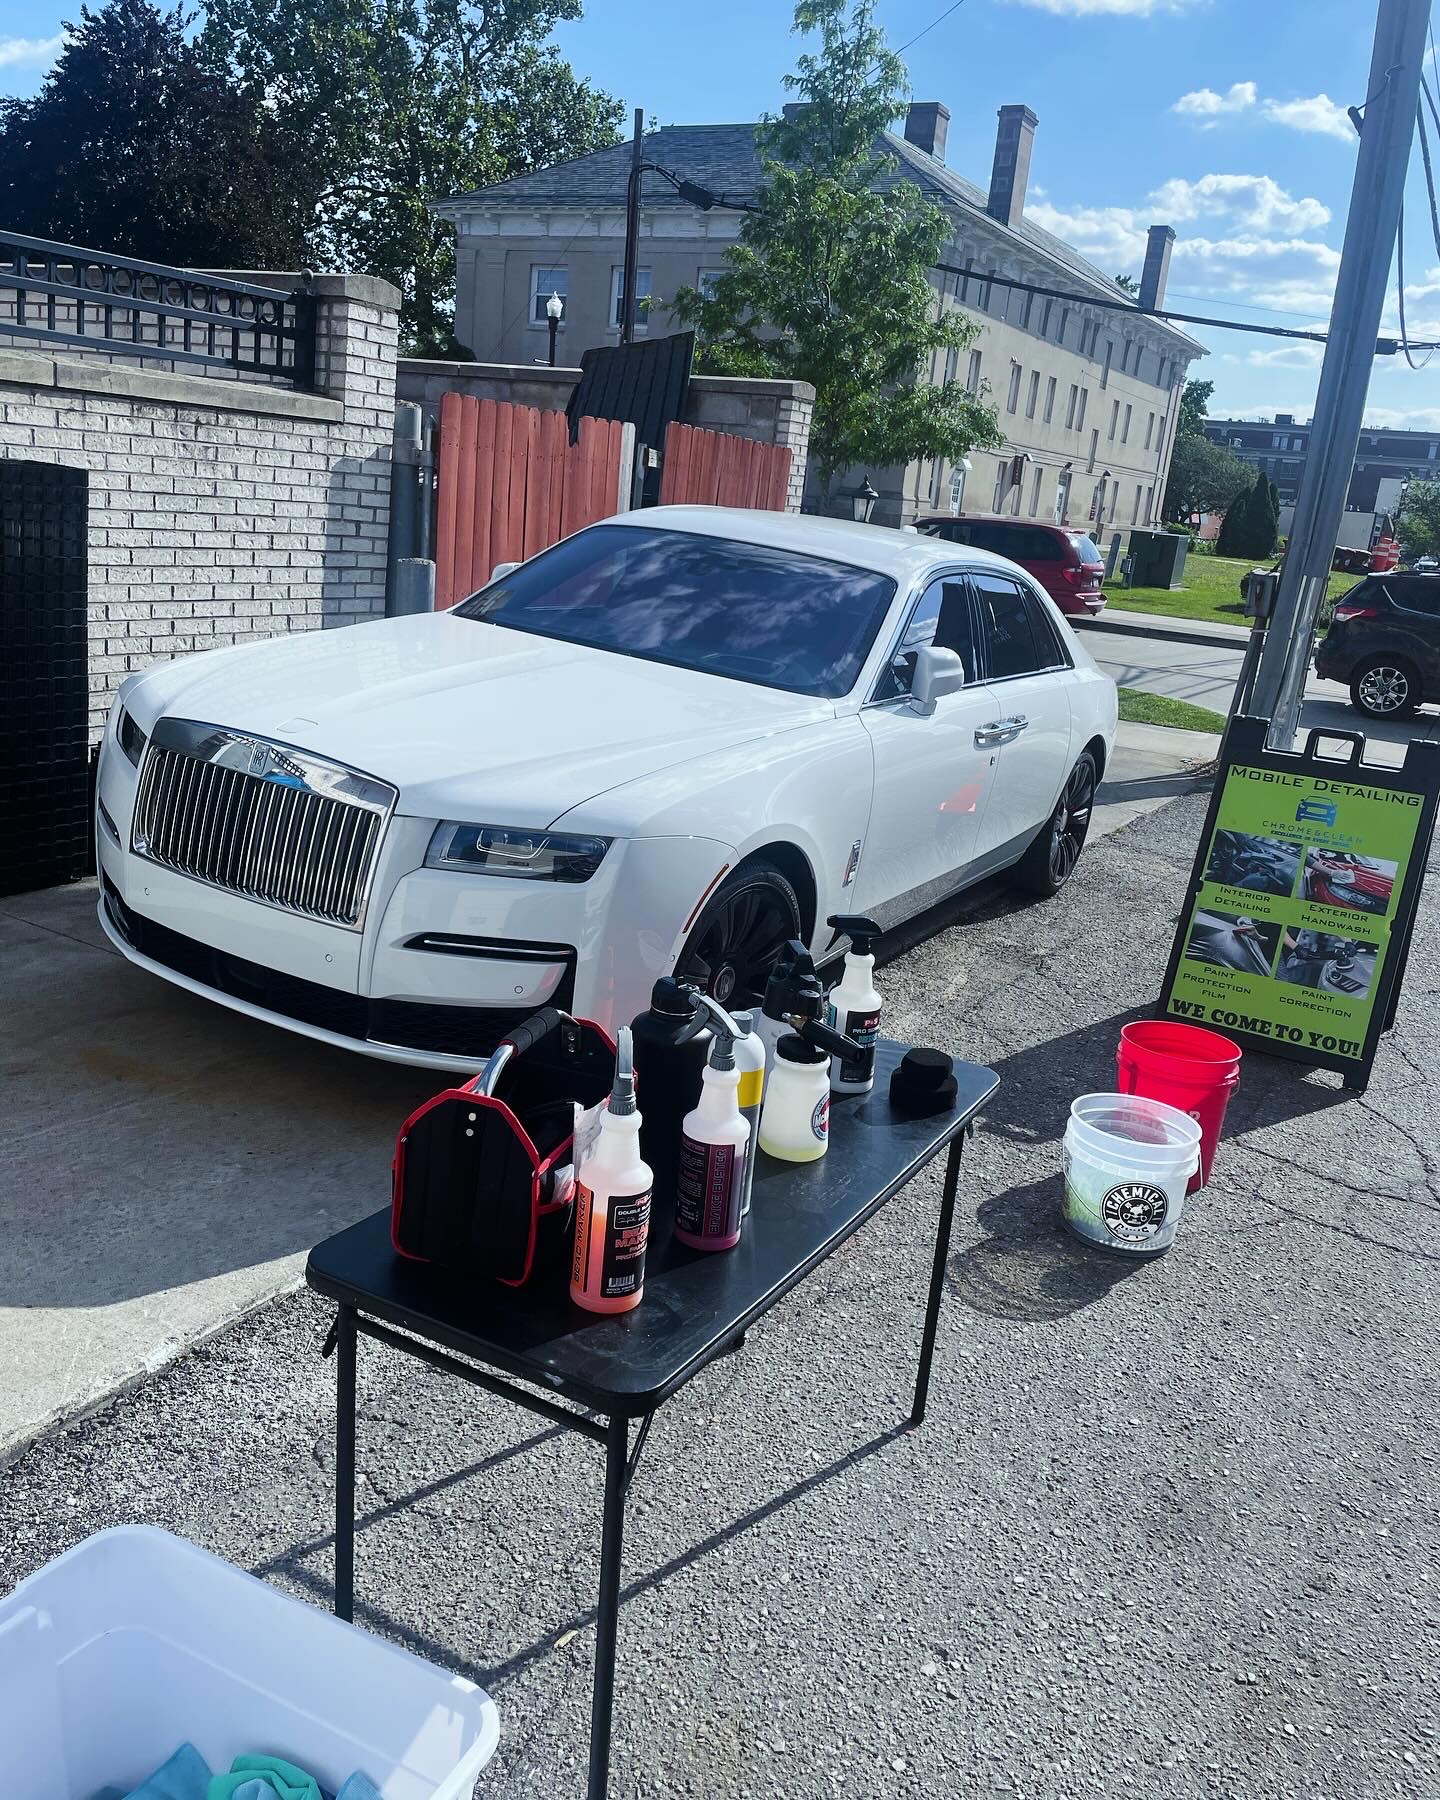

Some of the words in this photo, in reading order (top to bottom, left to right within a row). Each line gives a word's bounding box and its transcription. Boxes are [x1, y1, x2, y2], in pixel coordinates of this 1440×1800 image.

[1231, 766, 1305, 788] MOBILE
[1313, 779, 1420, 807] DETAILING
[1215, 896, 1271, 914] DETAILING
[1220, 886, 1271, 903] INTERIOR
[1301, 914, 1371, 935] HANDWASH
[1309, 904, 1369, 923] EXTERIOR
[1183, 973, 1251, 995] PROTECTION
[1204, 966, 1236, 980] PAINT
[1202, 989, 1226, 1000] FILM
[1302, 990, 1335, 1002] PAINT
[1279, 996, 1352, 1019] CORRECTION
[1173, 999, 1206, 1019] WE
[1211, 1008, 1273, 1035] COME
[1275, 1023, 1303, 1042] TO
[1309, 1031, 1360, 1057] YOU!
[713, 1148, 727, 1193] BUSTER
[1106, 1186, 1164, 1216] CHEMICAL
[577, 1193, 586, 1242] MAKER
[709, 1195, 722, 1233] BRAKE
